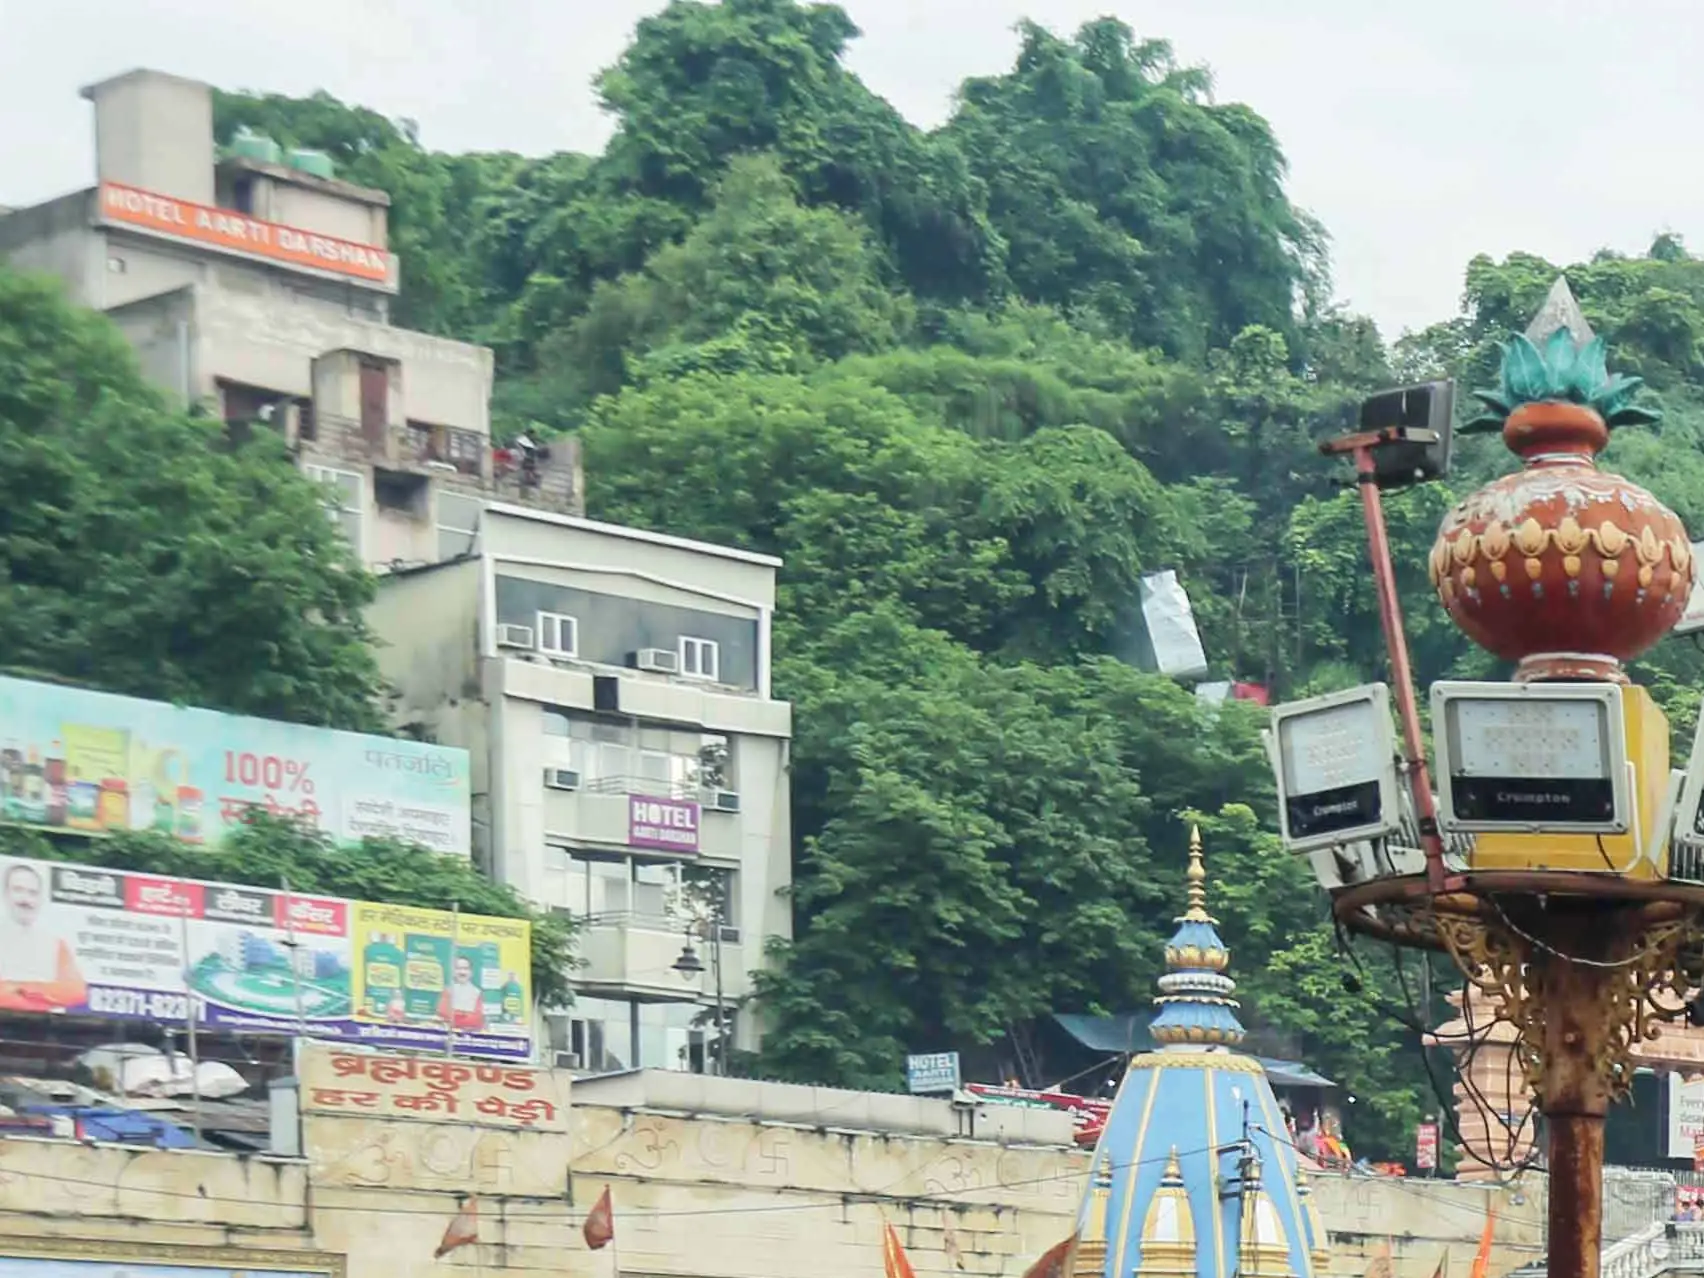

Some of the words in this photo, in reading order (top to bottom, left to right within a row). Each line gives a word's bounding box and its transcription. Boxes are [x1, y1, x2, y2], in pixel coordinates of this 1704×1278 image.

[107, 187, 187, 225] HOTEL
[196, 208, 270, 244] AARTI
[223, 750, 316, 795] 100%
[633, 801, 696, 829] HOTEL
[1497, 790, 1571, 804] Crompton
[309, 1087, 381, 1107] हर
[392, 1090, 458, 1114] की
[474, 1096, 556, 1126] पैड़ी
